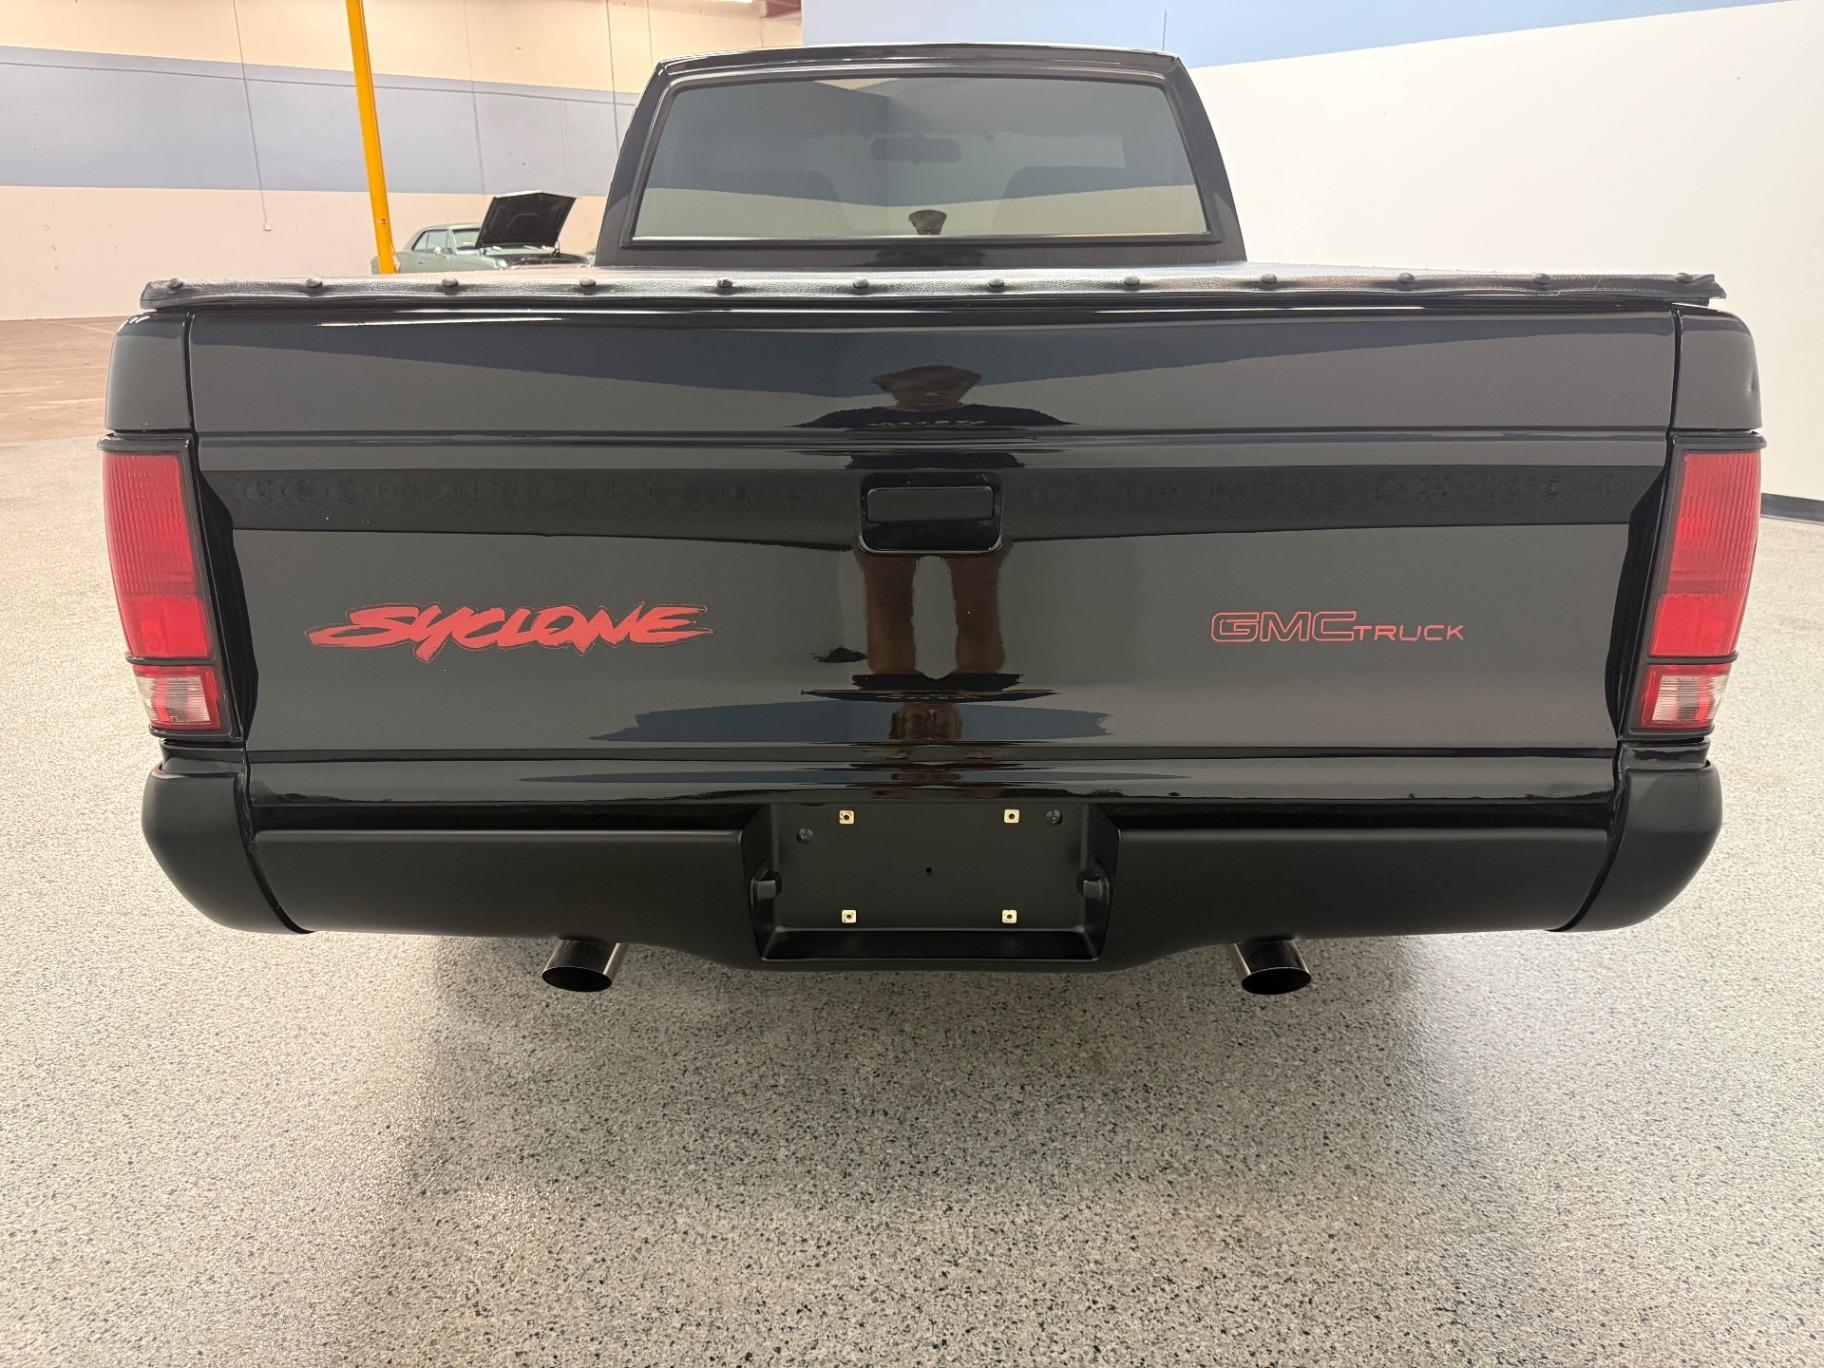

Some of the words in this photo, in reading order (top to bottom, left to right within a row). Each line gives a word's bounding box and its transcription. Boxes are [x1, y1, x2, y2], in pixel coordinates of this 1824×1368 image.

[307, 603, 713, 661] SYCLONE
[1211, 611, 1357, 642] GMC
[1353, 625, 1465, 641] TRUCK
